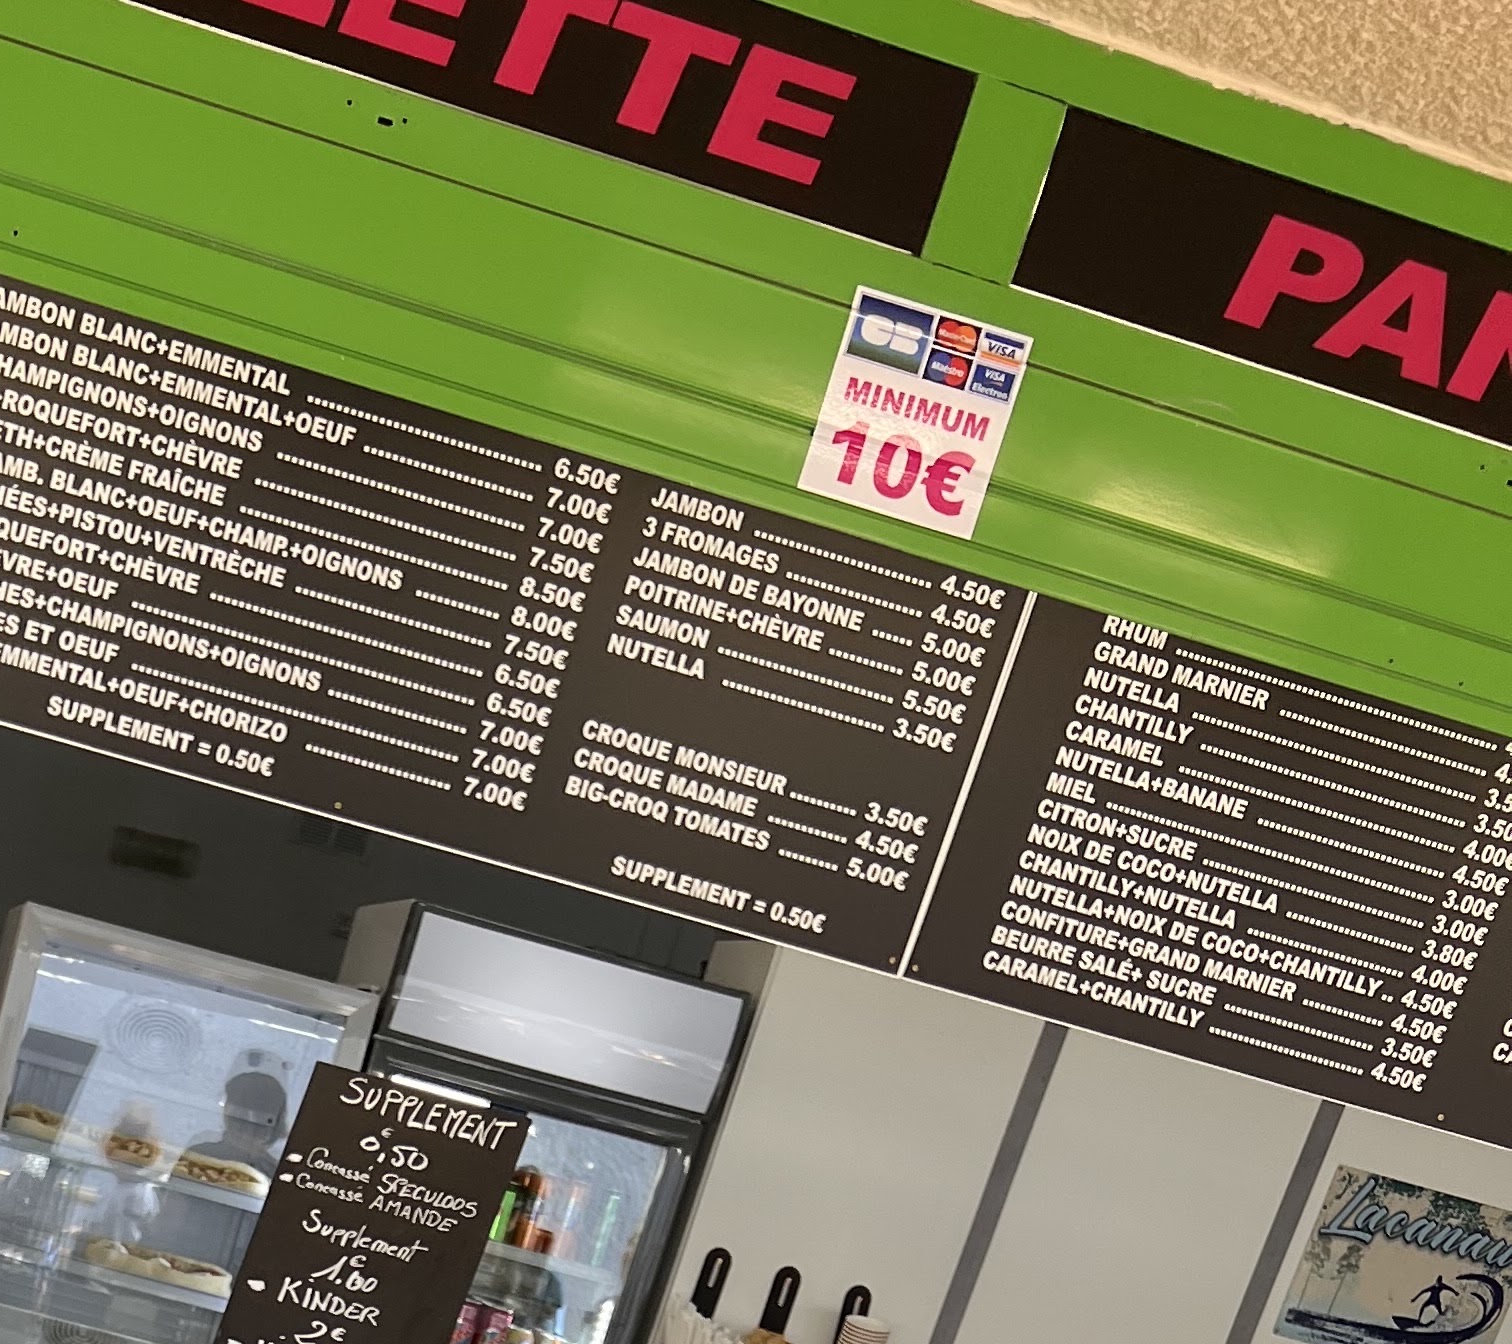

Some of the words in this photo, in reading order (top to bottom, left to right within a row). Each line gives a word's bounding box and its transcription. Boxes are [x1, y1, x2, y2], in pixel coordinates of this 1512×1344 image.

[240, 0, 857, 185] TTE
[79, 312, 290, 396] BLANC+EMMENTAL
[554, 457, 621, 494] 6.50€
[988, 342, 1016, 360] VISA
[71, 343, 357, 446] BLANC+EMMENTAL+OEUF
[546, 486, 612, 524] 7.00€
[843, 377, 991, 441] MINIMUM
[830, 420, 979, 518] 10€
[127, 458, 227, 506] FRAÎCHE
[518, 576, 586, 612] 8.50€
[529, 545, 595, 583] 7.50€
[537, 516, 603, 554] 7.00€
[641, 515, 658, 537] 3
[660, 521, 779, 574] FROMAGES
[930, 603, 996, 639] 4.50€
[650, 487, 744, 531] JAMBON
[939, 574, 1006, 610] 4.50€
[504, 633, 569, 670] 7.50€
[510, 605, 578, 641] 8.00€
[623, 574, 825, 651] POITRINE+CHÈVRE
[911, 660, 976, 696] 5.00€
[632, 546, 726, 590] JAMBON
[727, 573, 760, 601] DE
[761, 583, 865, 632] BAYONNE
[920, 631, 986, 667] 5.00€
[1102, 614, 1168, 650] RHUM
[23, 619, 56, 645] ET
[58, 629, 120, 663] OEUF
[471, 747, 536, 783] 7.00€
[486, 691, 552, 727] 6.50€
[494, 663, 560, 699] 6.50€
[606, 632, 704, 680] NUTELLA
[892, 717, 957, 753] 3.50€
[615, 604, 710, 649] SAUMON
[901, 688, 967, 724] 5.50€
[1082, 666, 1179, 713] NUTELLA
[1093, 641, 1169, 679] GRAND
[1170, 663, 1269, 710] MARNIER
[46, 695, 195, 753] SUPPLEMENT
[215, 743, 275, 777] 0.50€
[479, 719, 544, 755] 7.00€
[1065, 720, 1163, 767] CARAMEL
[1074, 693, 1194, 744] CHANTILLY
[463, 775, 528, 811] 7.00€
[573, 747, 664, 790] CROQUE
[671, 773, 758, 817] MADAME
[854, 829, 919, 864] 4.50€
[581, 719, 673, 762] CROQUE
[673, 745, 787, 796] MONSIEUR
[863, 801, 928, 836] 3.50€
[1054, 745, 1249, 819] NUTELLA+BANANE
[1451, 864, 1510, 896] 4.50€
[564, 774, 669, 823] BIG-CROQ
[673, 805, 771, 850] TOMATES
[845, 856, 910, 891] 5.00€
[1037, 798, 1198, 861] CITRON+SUCRE
[1431, 914, 1489, 946] 3.00€
[1045, 771, 1096, 804] MIEL
[1441, 889, 1499, 921] 3.00€
[610, 855, 751, 911] SUPPLEMENT
[769, 901, 826, 934] 0.50€
[1008, 874, 1168, 937] NUTELLA+NOIX
[1167, 920, 1200, 946] DE
[1400, 989, 1457, 1020] 4.50€
[1018, 849, 1236, 929] CHANTILLY+NUTELLA
[1410, 964, 1468, 995] 4.00€
[1026, 823, 1083, 856] NOIX
[1083, 839, 1115, 865] DE
[1116, 849, 1278, 914] COCO+NUTELLA
[1420, 939, 1478, 971] 3.80€
[982, 950, 1205, 1028] CARAMEL+CHANTILLY
[1370, 1062, 1427, 1092] 4.50€
[990, 924, 1077, 966] BEURRE
[1145, 969, 1217, 1005] SUCRE
[1380, 1037, 1437, 1068] 3.50€
[1000, 900, 1200, 973] CONFITURE+GRAND
[1201, 957, 1297, 1001] MARNIER
[1390, 1013, 1447, 1044] 4.50€
[340, 1077, 518, 1150] SUPPLEMENT
[294, 1172, 364, 1203] Concassé
[369, 1195, 458, 1232] AMANDE
[302, 1209, 429, 1263] Supplement
[306, 1147, 371, 1184] Concassé
[377, 1173, 478, 1218] SPECULOOS
[1319, 1176, 1512, 1268] Lacanau
